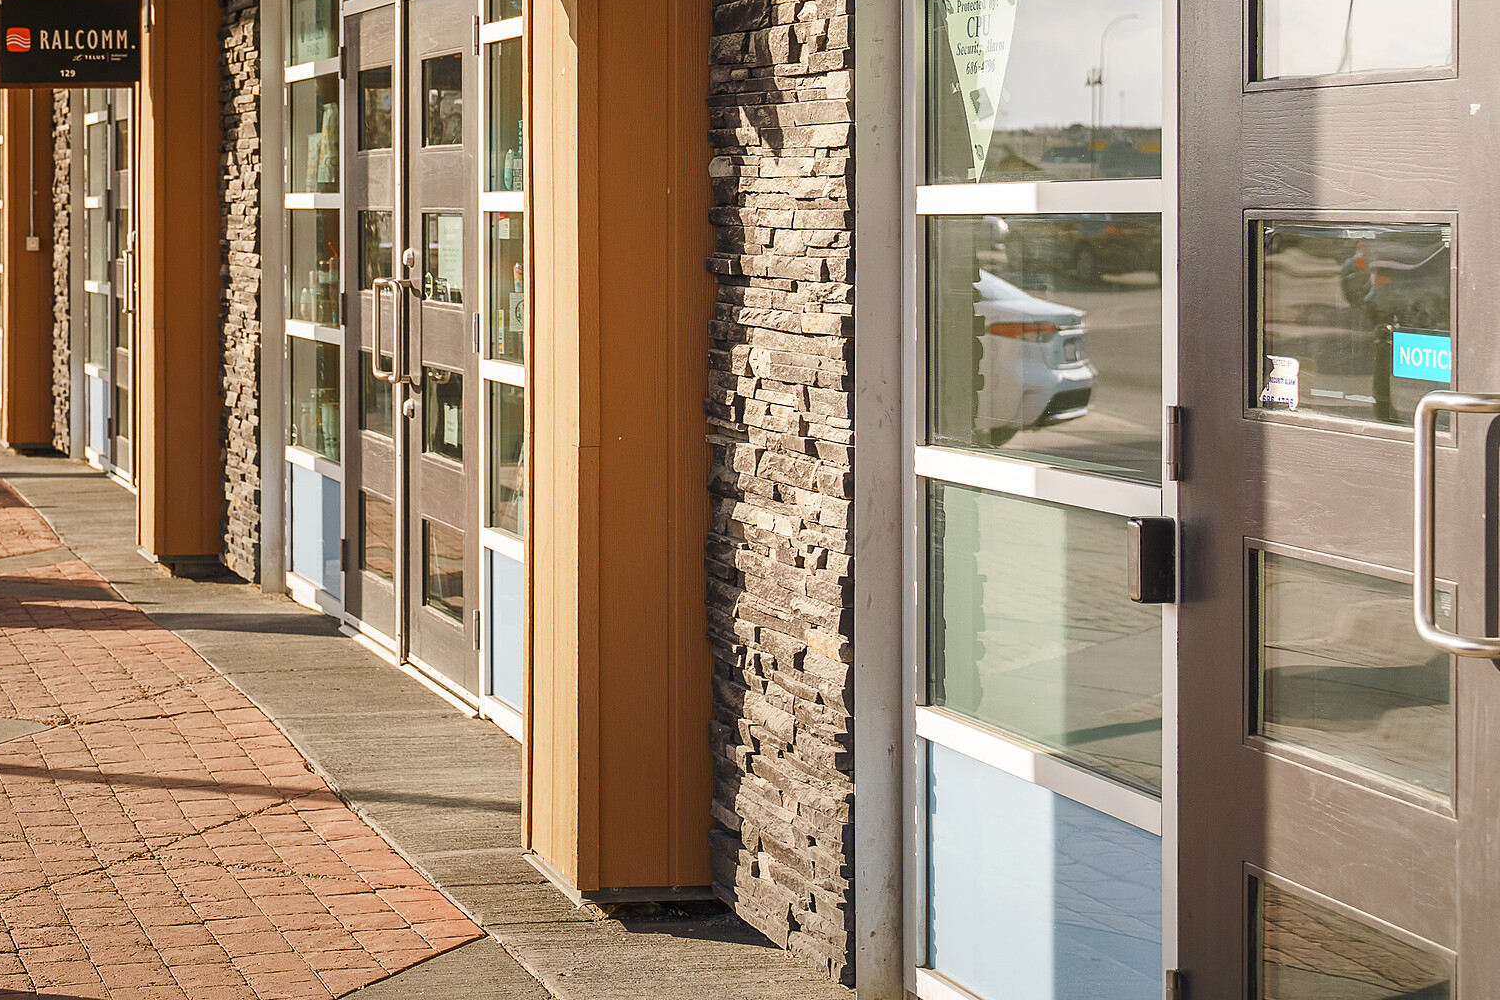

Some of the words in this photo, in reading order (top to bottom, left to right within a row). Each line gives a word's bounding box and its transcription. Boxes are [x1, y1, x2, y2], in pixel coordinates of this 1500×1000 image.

[966, 14, 991, 38] CPU
[956, 40, 983, 56] Security
[985, 39, 1005, 53] Alarm
[60, 69, 76, 78] 129
[1399, 346, 1452, 370] NOTIC
